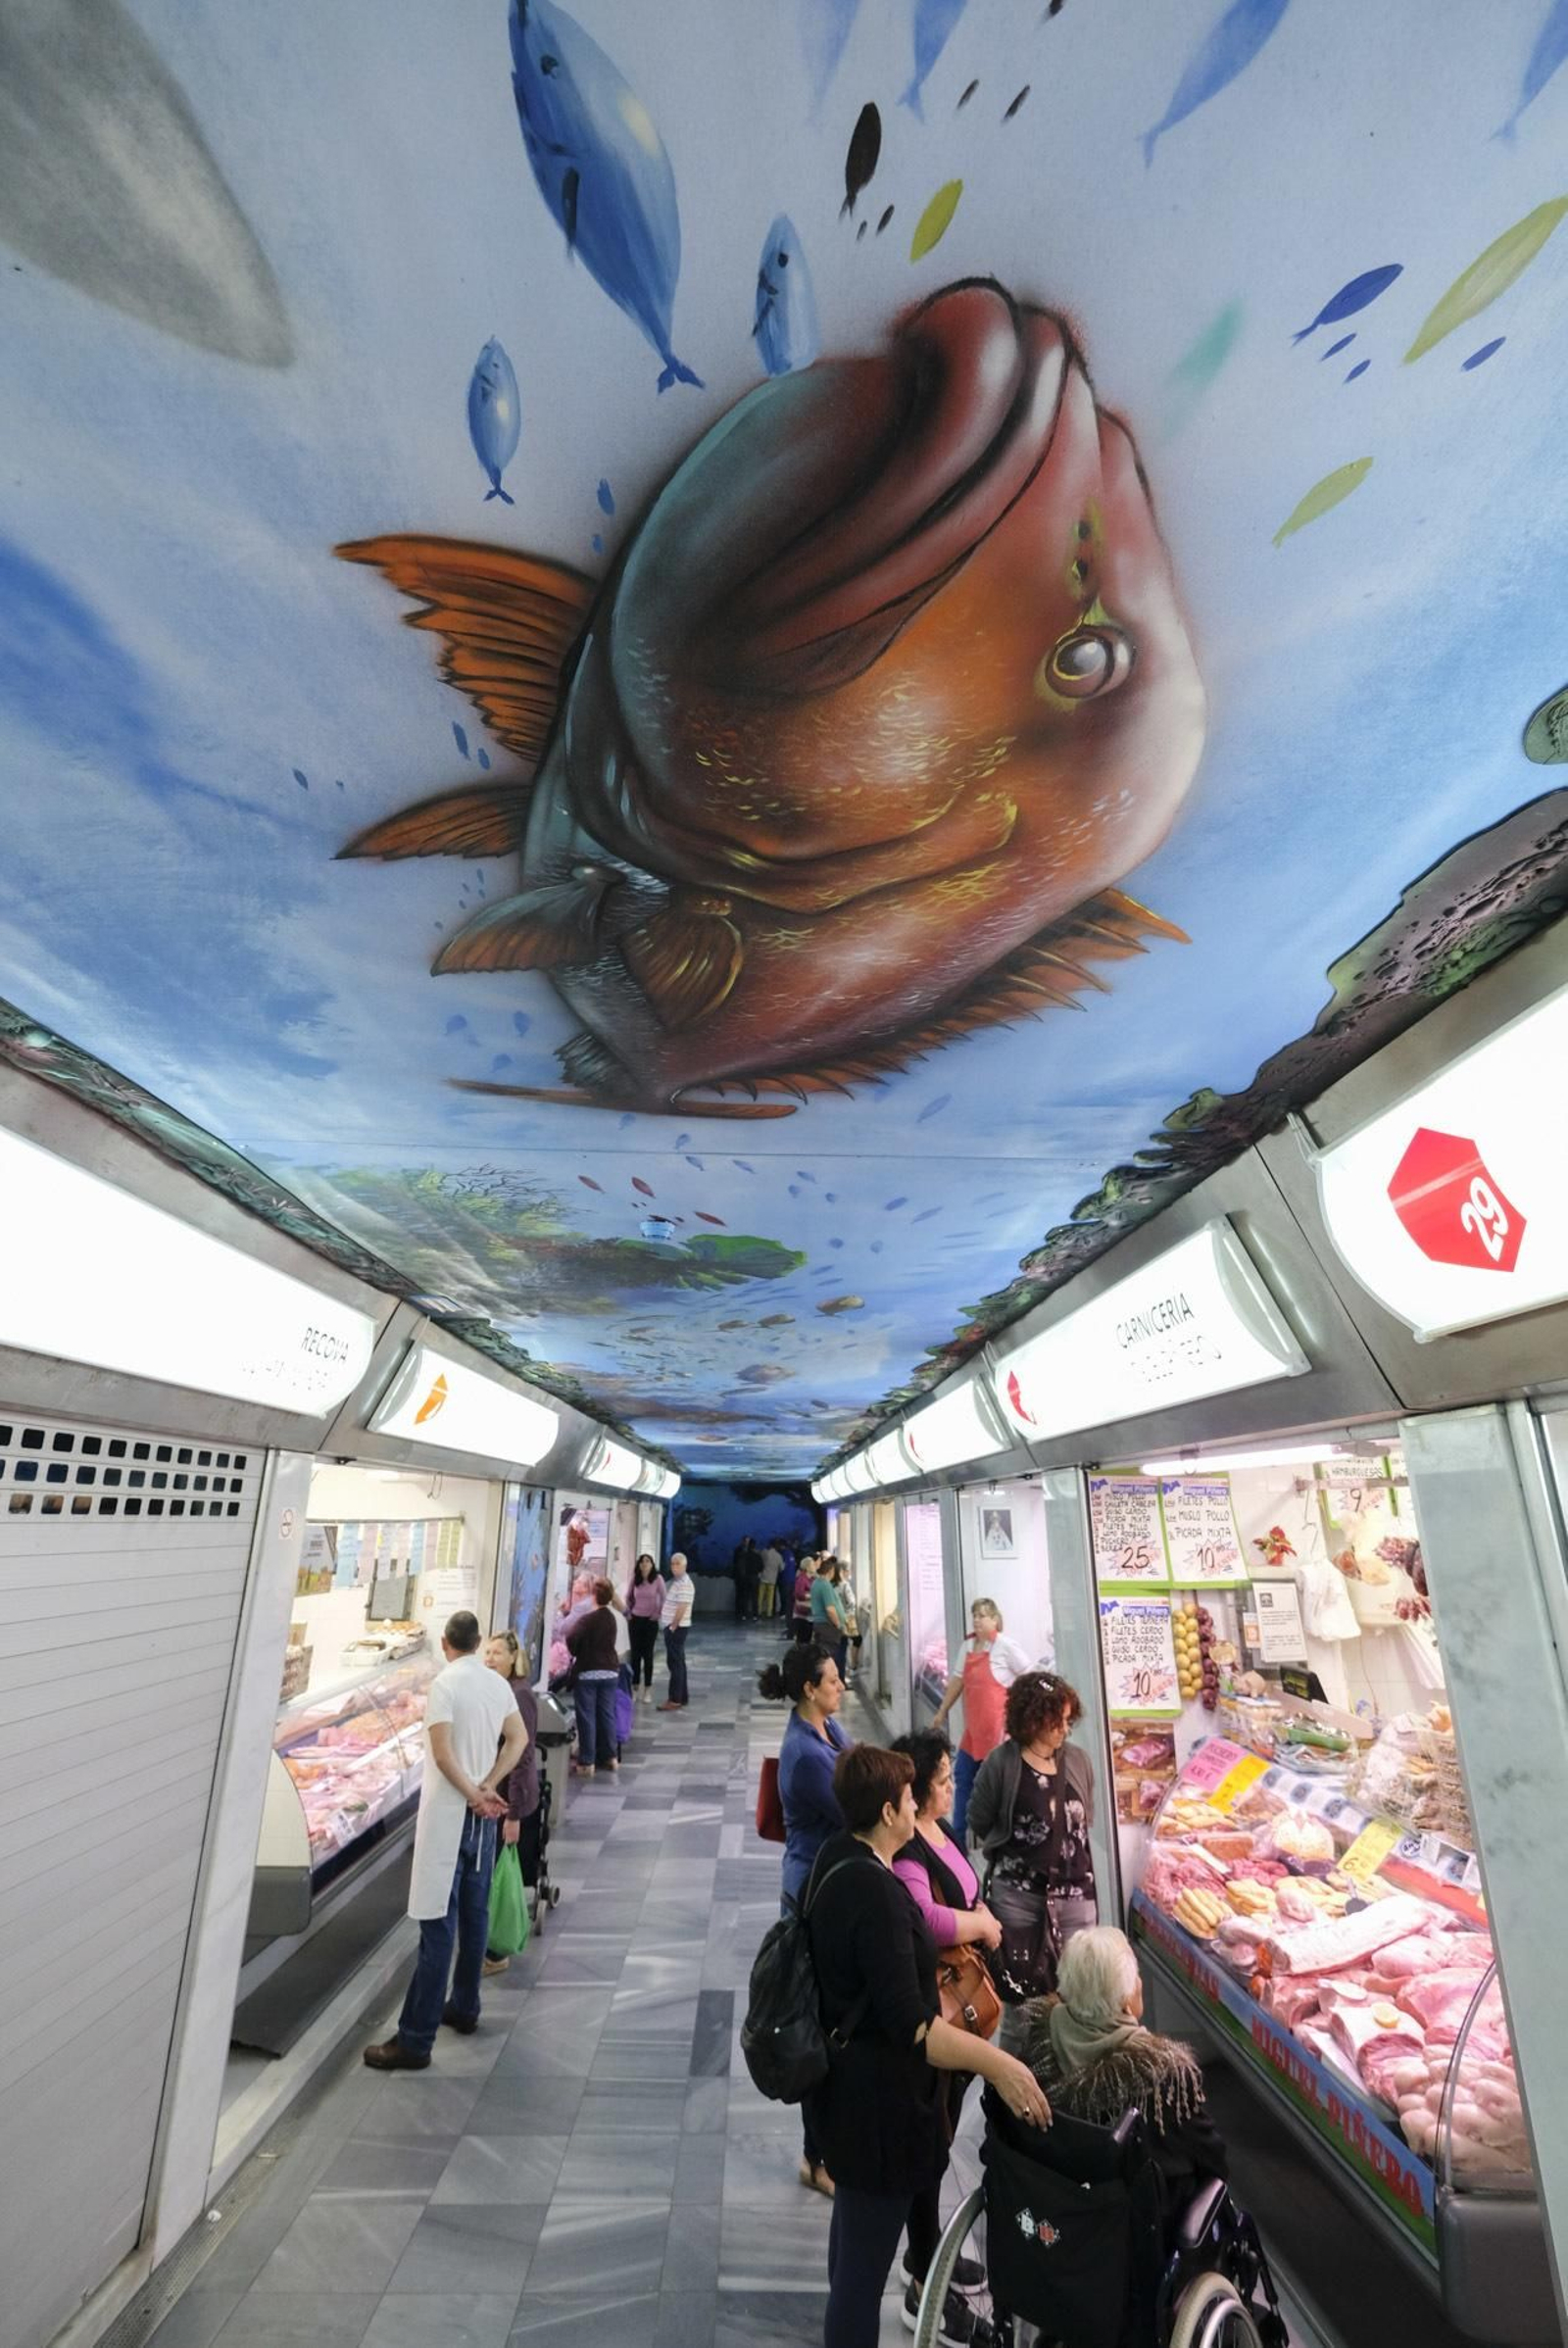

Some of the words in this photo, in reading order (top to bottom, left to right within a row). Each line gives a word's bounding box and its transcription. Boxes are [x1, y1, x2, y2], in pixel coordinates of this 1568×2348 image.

[1460, 1176, 1509, 1262] 29
[1115, 1292, 1195, 1348] CARNICERIA
[1178, 1495, 1203, 1506] FILETES
[1207, 1495, 1229, 1506] POLLO
[1349, 1488, 1362, 1512] 9
[1178, 1510, 1200, 1521] MUSLO
[1206, 1509, 1230, 1521] POLLO
[1175, 1527, 1202, 1538] PICADA
[1206, 1527, 1232, 1538] MIXTA
[1121, 1545, 1151, 1569] 25
[1251, 2013, 1324, 2119] MIGUEL
[1327, 2088, 1425, 2219] PIÑERO
